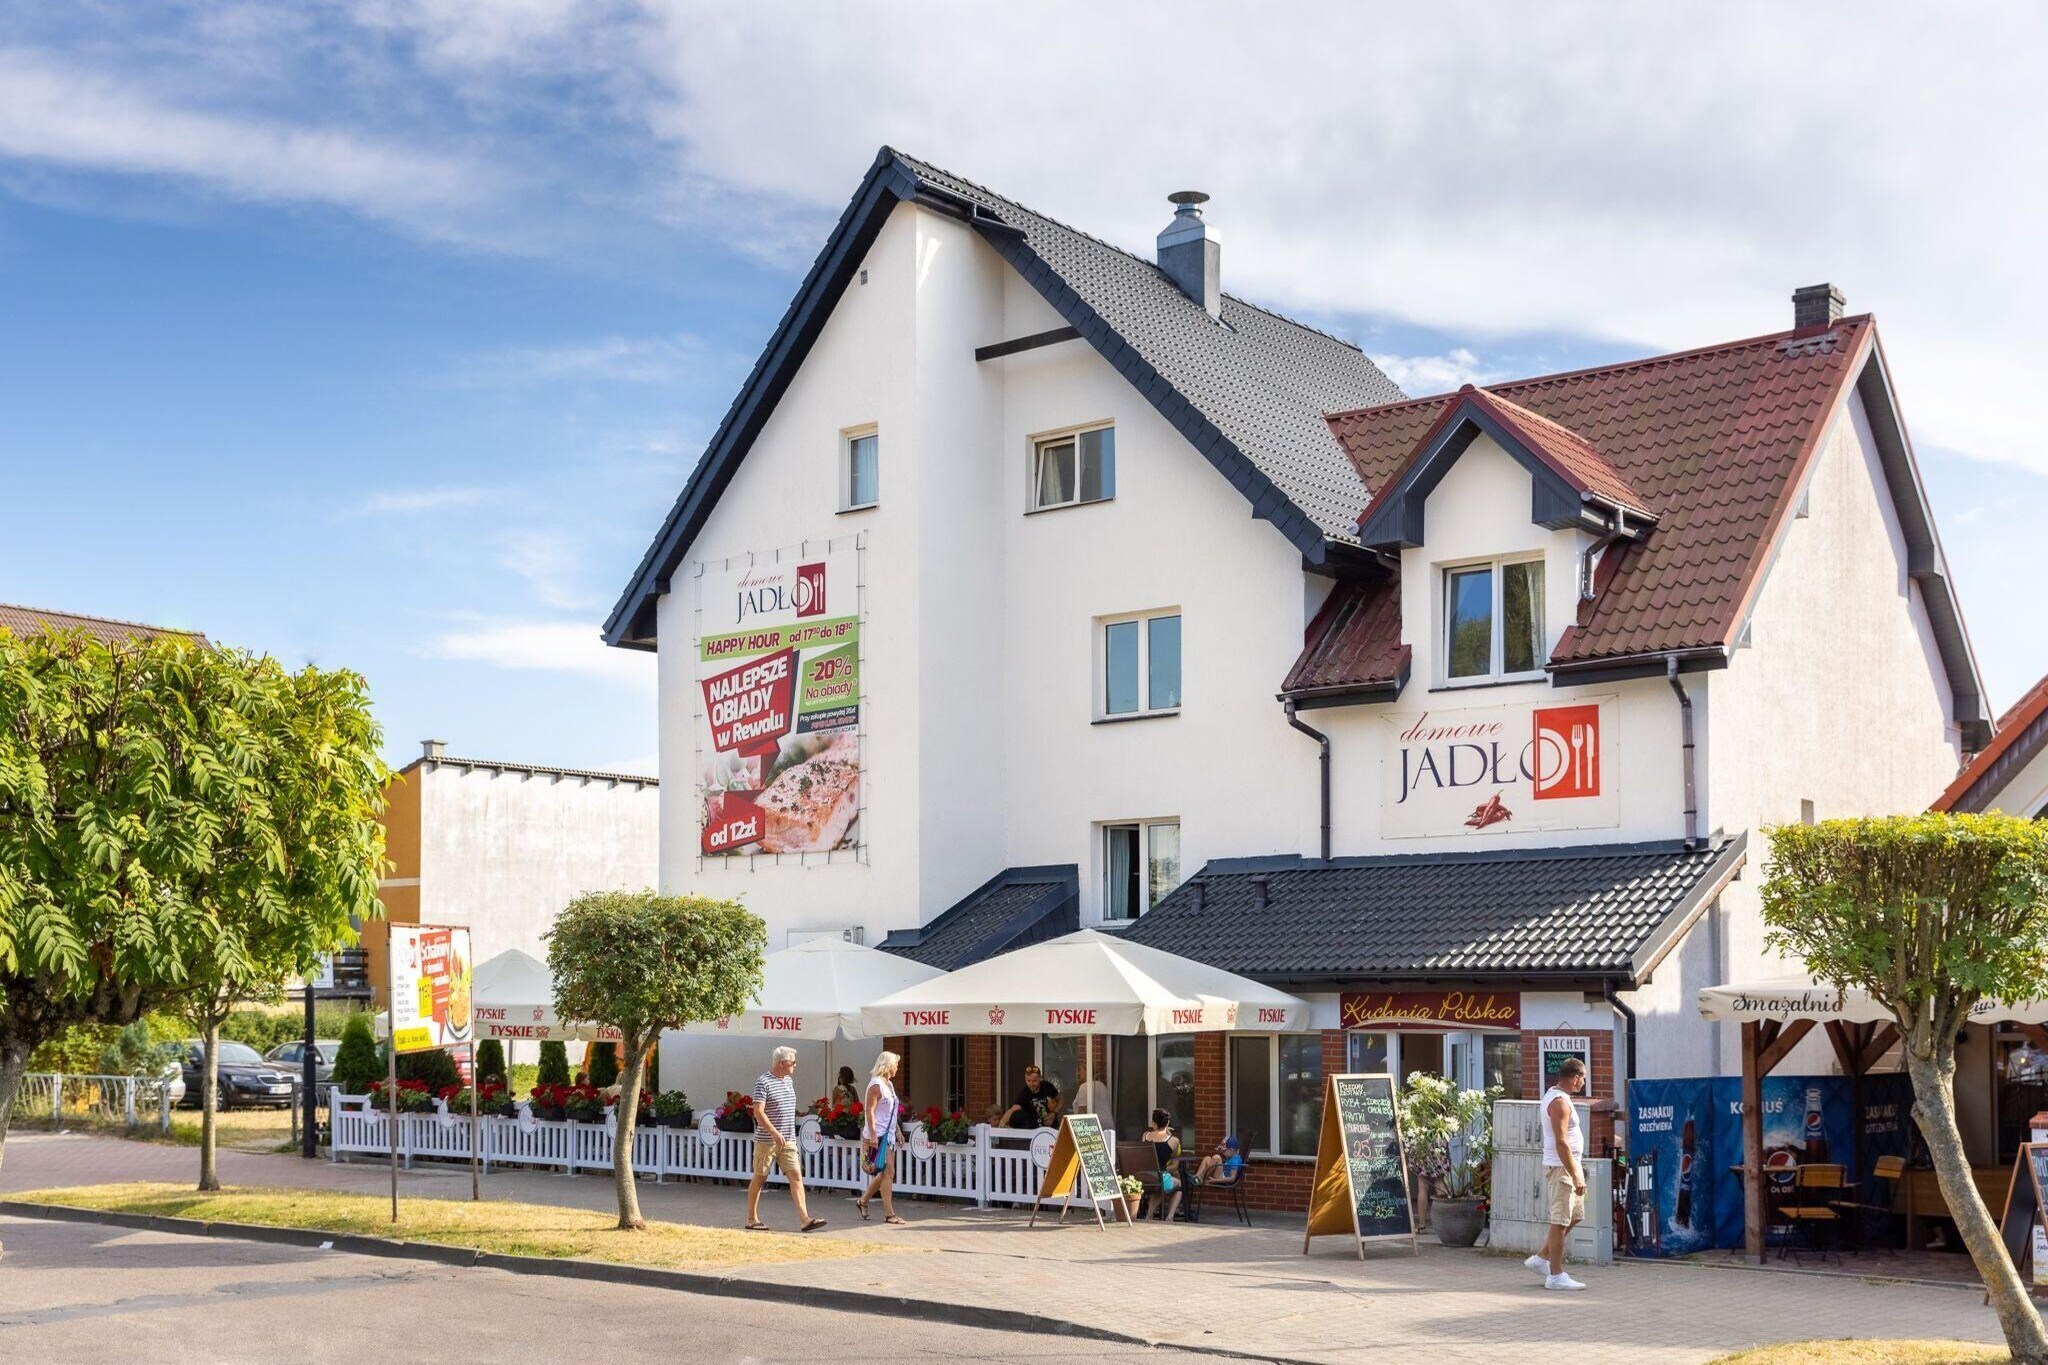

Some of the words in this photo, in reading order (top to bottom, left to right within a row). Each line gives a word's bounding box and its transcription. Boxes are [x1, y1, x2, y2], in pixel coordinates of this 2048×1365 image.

[737, 571, 784, 588] domowe
[706, 637, 746, 655] HAPPY
[747, 632, 781, 650] HOUR
[789, 631, 801, 643] od
[820, 629, 832, 639] do
[808, 656, 852, 683] -20%
[709, 655, 789, 703] NAJLEPSZE
[805, 686, 819, 700] Na
[712, 685, 774, 727] OBIADY
[716, 730, 731, 748] w
[732, 709, 785, 744] Rewalu
[1399, 711, 1504, 744] domowe
[1396, 738, 1562, 804] JADŁO
[711, 825, 728, 847] od
[730, 816, 757, 842] 12zł
[475, 1008, 507, 1020] TYSKIE
[1258, 1008, 1286, 1023] TYSKIE
[1342, 994, 1433, 1024] Kuchnia
[1438, 991, 1516, 1020] Polska
[762, 1015, 802, 1031] TYSKIE
[902, 1010, 950, 1026] TYSKIE
[1046, 1009, 1097, 1024] TYSKIE
[1172, 1008, 1203, 1024] TYSKIE
[489, 1025, 534, 1038] TYSKIE
[595, 1026, 623, 1039] TYSKIE
[1543, 1038, 1586, 1050] KITCHEN
[1638, 1105, 1674, 1120] ZASMAKUJ
[1639, 1120, 1673, 1132] ORZEŹWIENIA
[1353, 1139, 1371, 1158] 25
